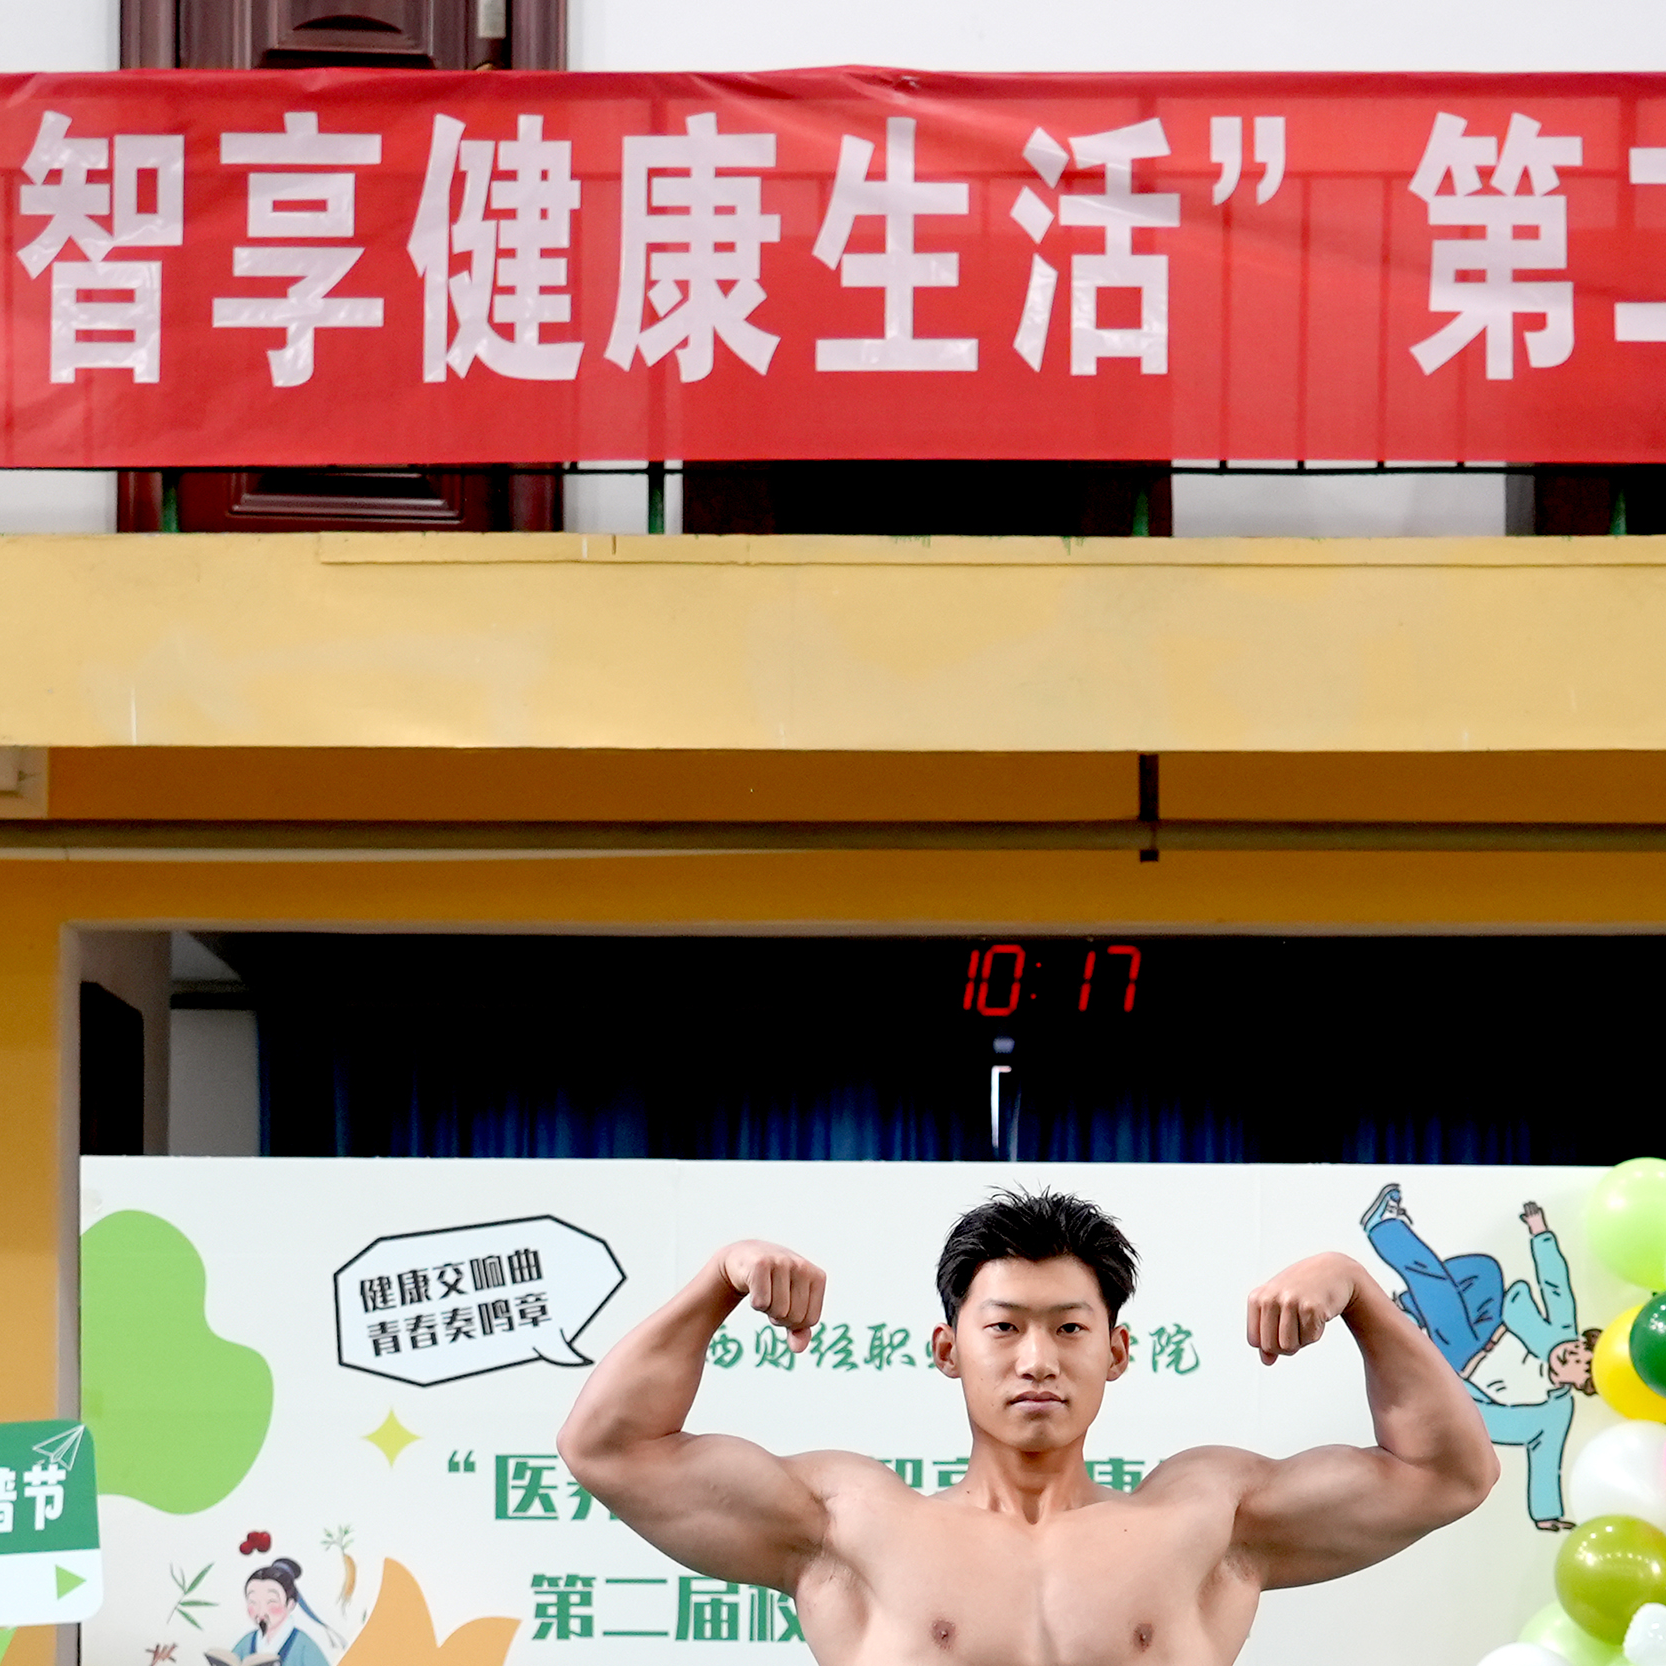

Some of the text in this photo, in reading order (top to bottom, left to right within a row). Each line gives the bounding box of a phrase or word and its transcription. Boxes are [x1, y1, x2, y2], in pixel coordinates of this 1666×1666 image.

[963, 944, 1141, 1017] 10:17
[360, 1248, 543, 1314] 健康交响曲
[367, 1292, 552, 1358] 青春奏鸣章
